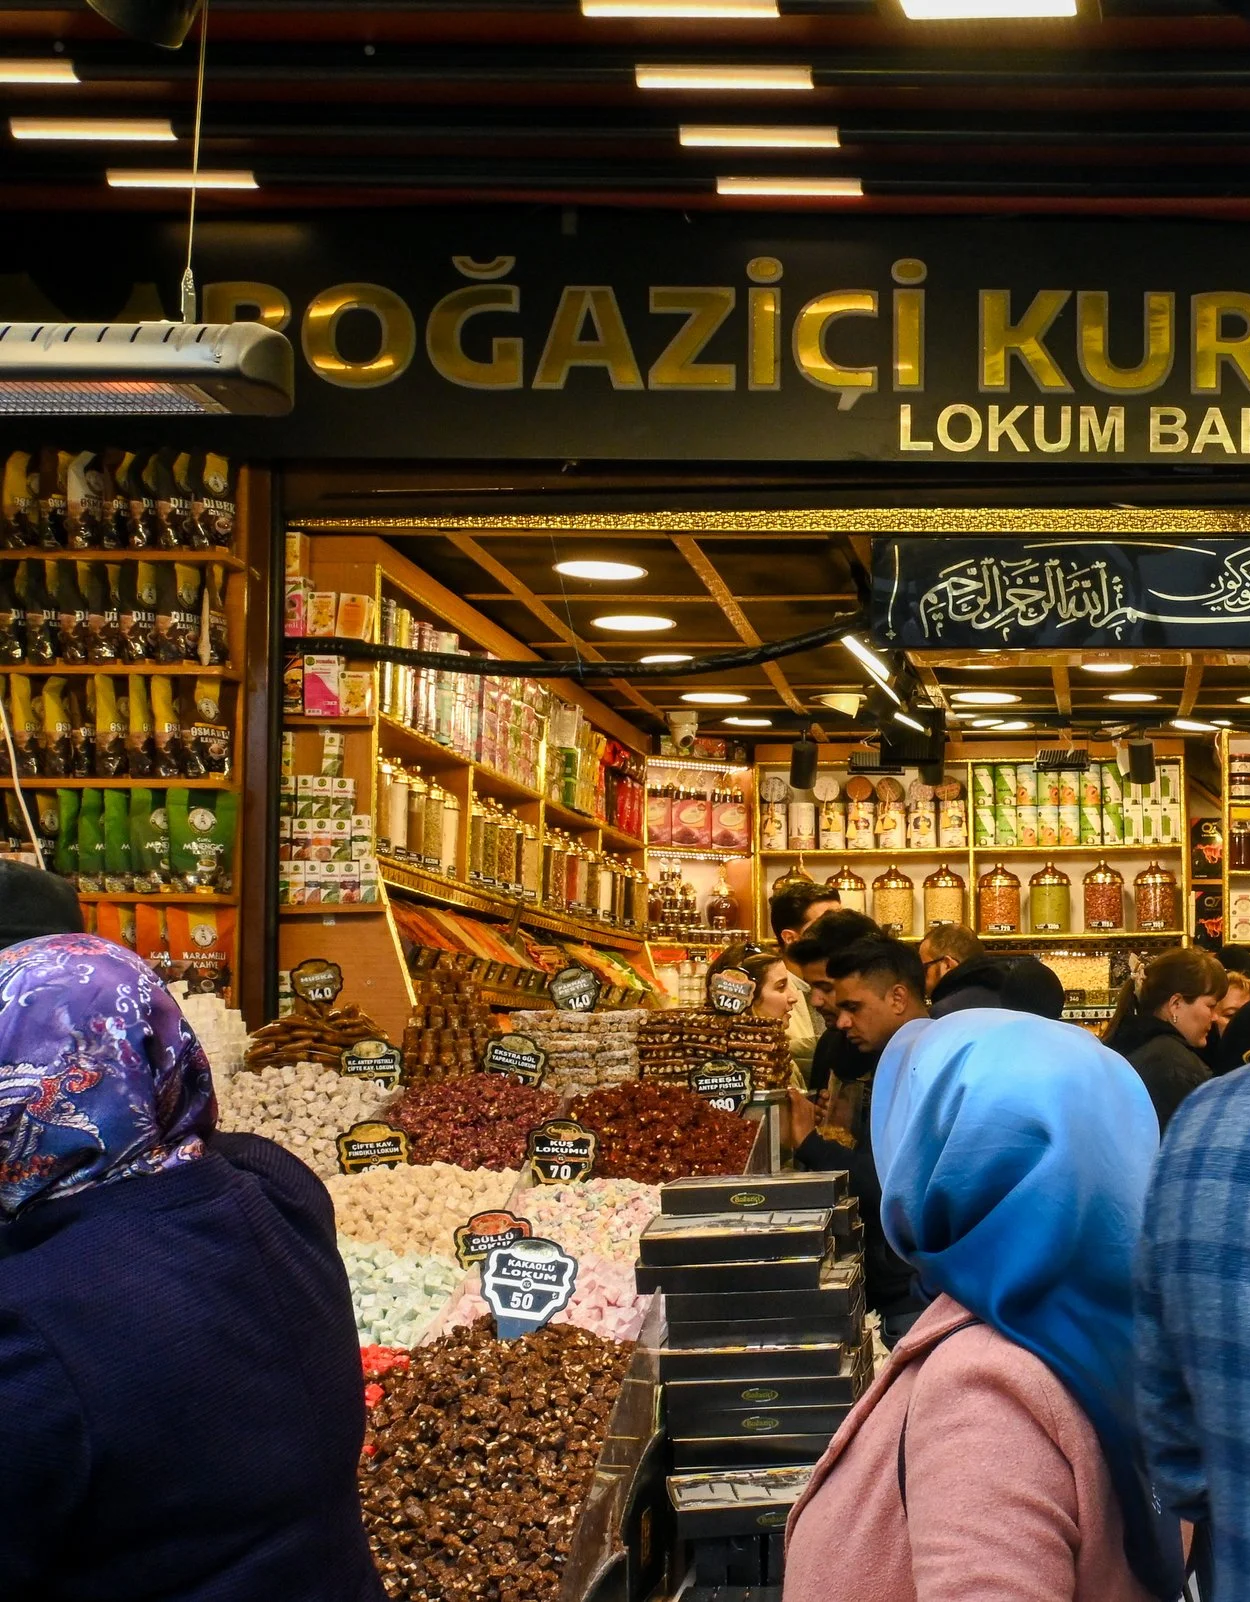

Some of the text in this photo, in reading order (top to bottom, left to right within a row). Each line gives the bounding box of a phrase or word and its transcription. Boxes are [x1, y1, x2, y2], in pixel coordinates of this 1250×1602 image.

[899, 403, 1126, 453] LOKUM
[300, 973, 334, 983] MUSKA
[308, 986, 332, 1001] 140
[568, 994, 591, 1010] 140
[718, 994, 741, 1010] 140
[493, 1047, 536, 1064] EKSTRA GÜL
[697, 1083, 719, 1092] ANTEP
[351, 1142, 375, 1151] ÇİFTE
[377, 1147, 400, 1156] LOKUM
[535, 1146, 588, 1156] LOKUMU
[549, 1140, 575, 1150] KUŞ
[549, 1164, 571, 1180] 70
[471, 1232, 514, 1246] GÜLLÜ
[507, 1258, 556, 1273] KAKAOLU
[501, 1267, 558, 1283] LOKUM
[509, 1292, 535, 1311] 50
